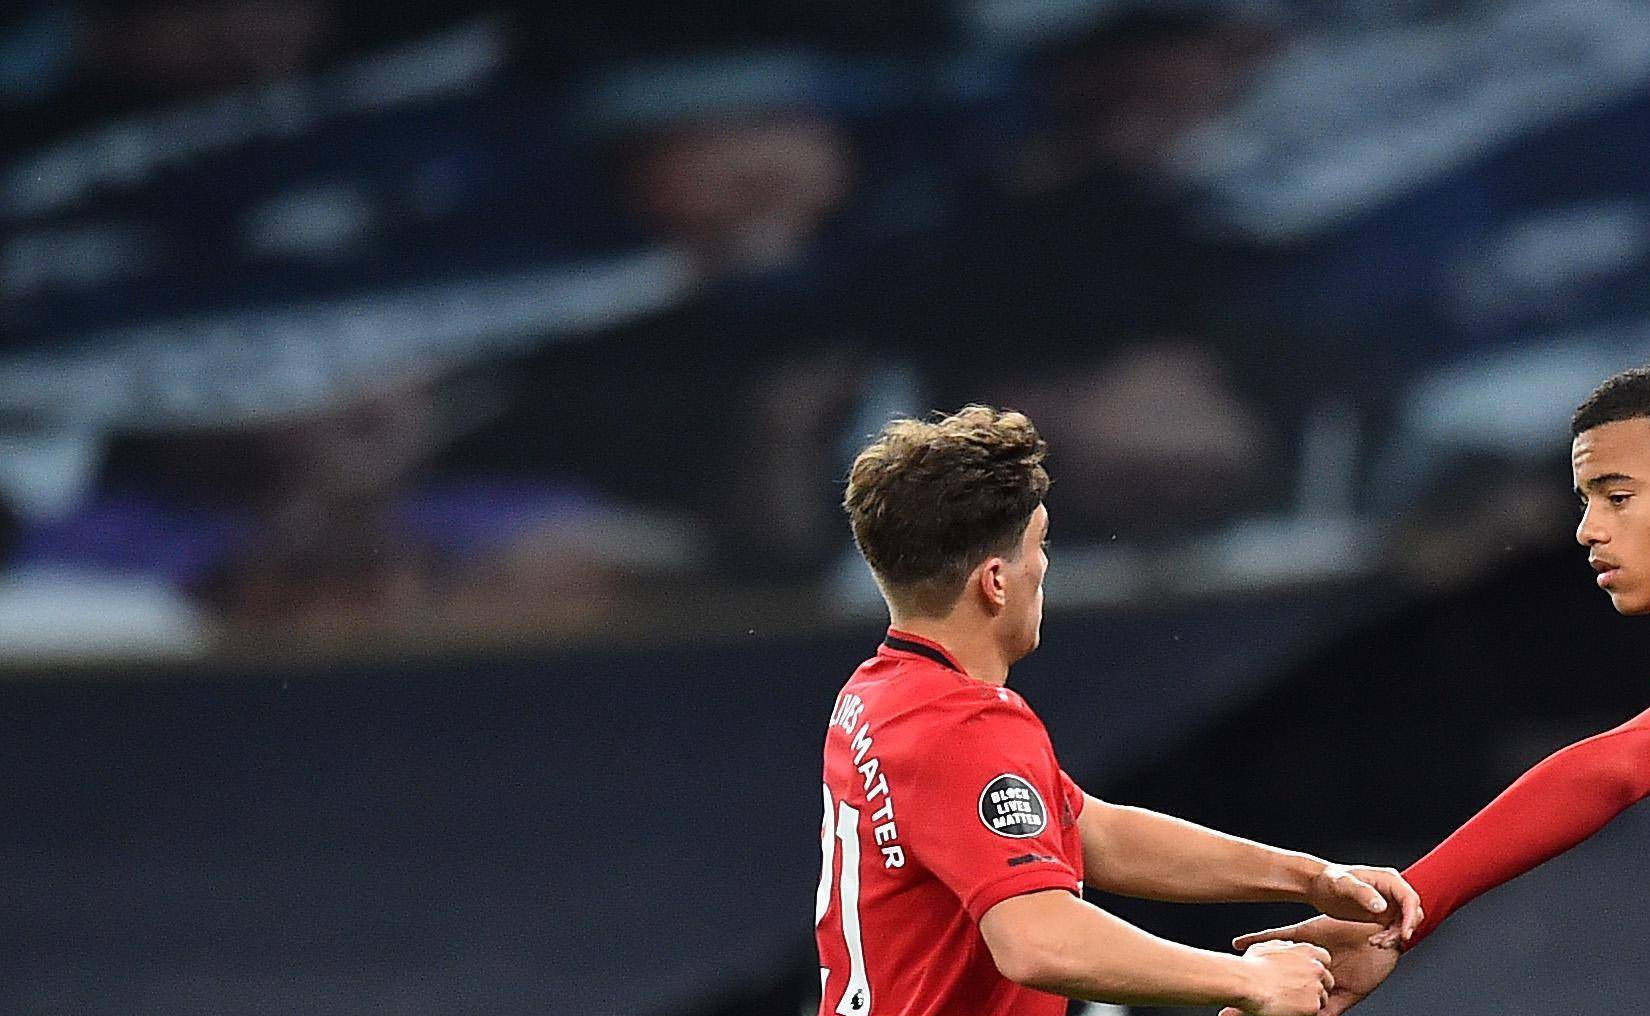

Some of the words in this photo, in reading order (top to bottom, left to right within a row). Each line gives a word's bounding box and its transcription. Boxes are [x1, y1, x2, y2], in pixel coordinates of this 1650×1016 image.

[850, 722, 904, 869] MATTER
[996, 800, 1032, 815] LIVES
[992, 812, 1042, 829] MATTER
